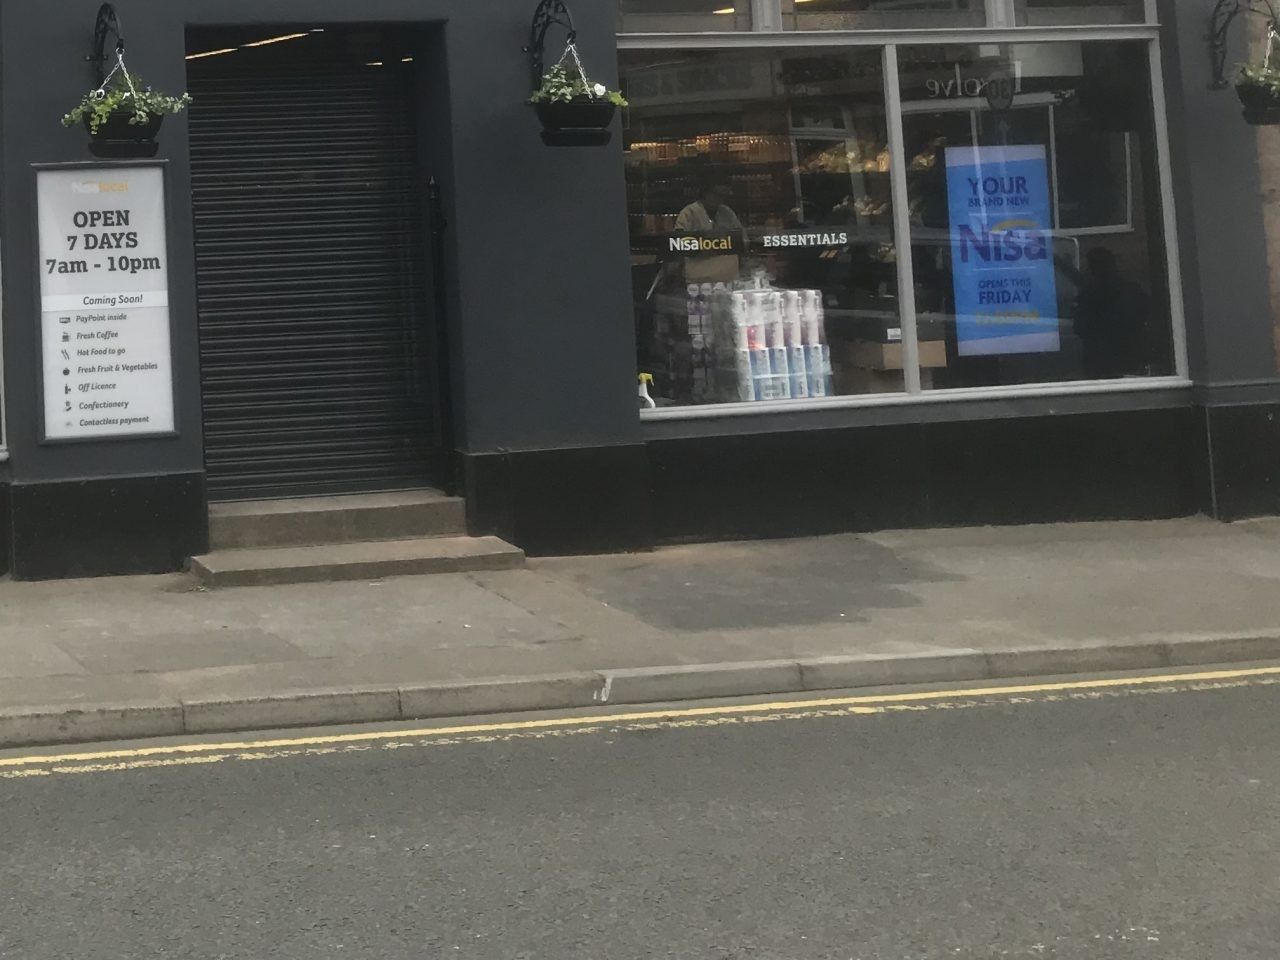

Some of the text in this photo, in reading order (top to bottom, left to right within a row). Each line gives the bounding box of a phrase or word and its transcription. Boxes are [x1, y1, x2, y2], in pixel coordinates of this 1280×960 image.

[968, 176, 1028, 195] YOUR
[968, 196, 1030, 207] BRAND NEW
[73, 210, 130, 228] OPEN
[67, 232, 138, 251] 7 DAYS
[669, 236, 732, 252] Nisalocal
[763, 232, 848, 247] ESSENTIALS
[958, 224, 1048, 262] Nisa
[46, 259, 88, 274] 7am
[108, 256, 161, 274] 10pm
[978, 278, 1032, 289] OPENS THIS
[83, 295, 143, 306] Coming Soon!
[979, 290, 1032, 304] FRIDAY
[75, 313, 127, 323] PayPoint inside
[76, 331, 119, 340] Fresh Coffee
[91, 348, 107, 356] Food
[117, 348, 126, 356] go
[77, 366, 96, 374] Fresh
[97, 365, 114, 373] Fruit
[121, 362, 158, 373] Vegetables
[78, 382, 117, 392] Off Licence
[79, 416, 150, 427] Contactless payment
